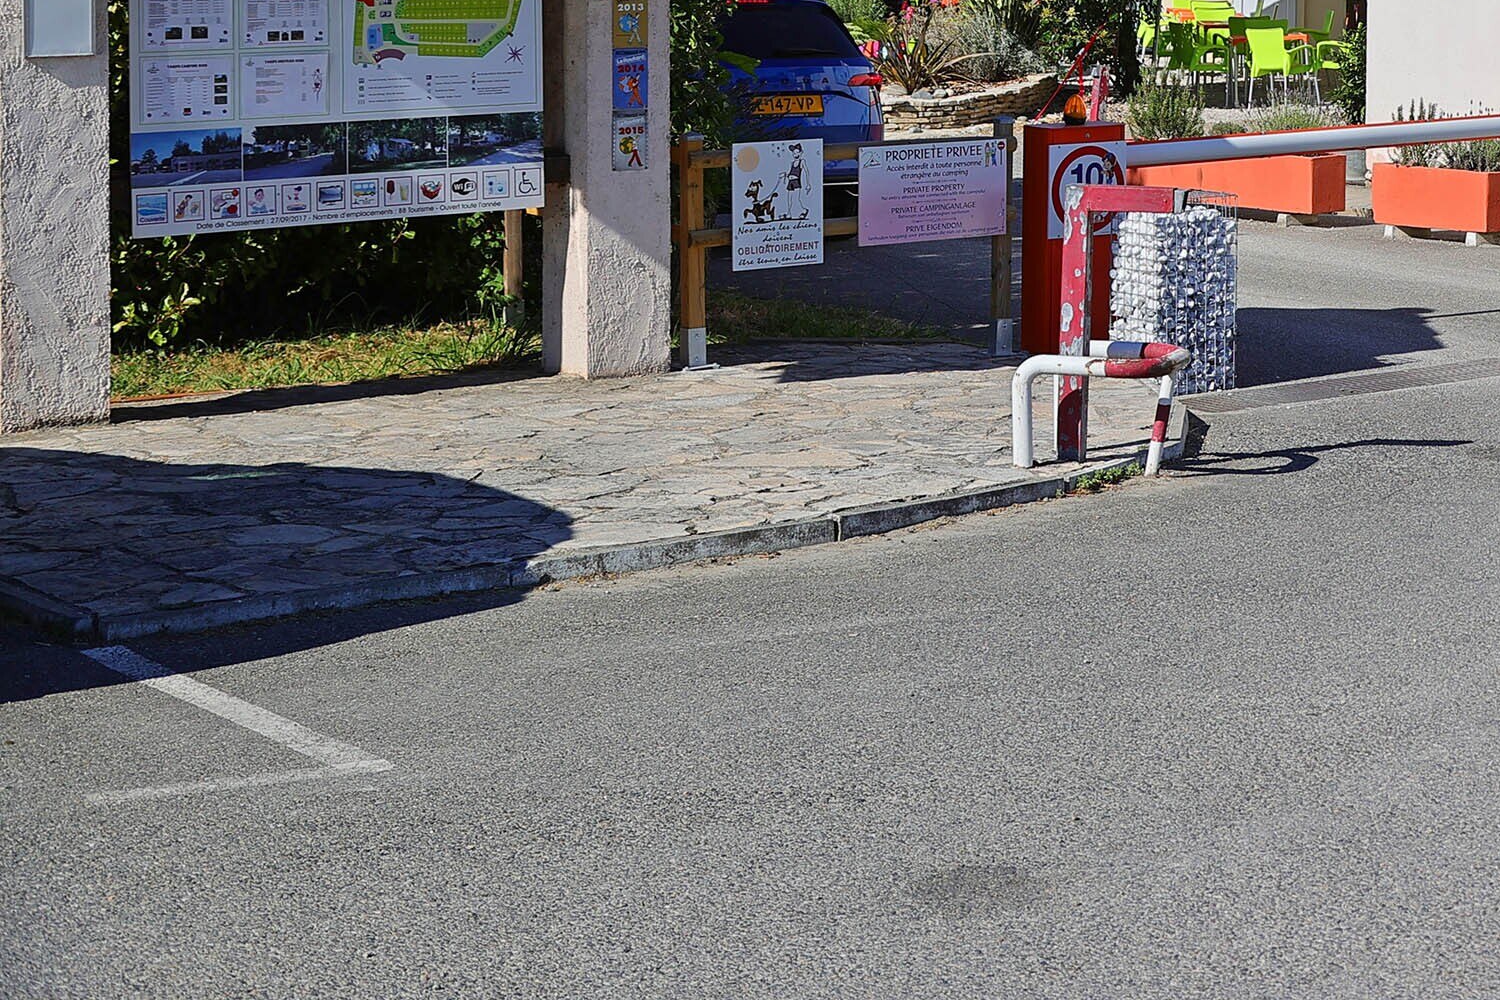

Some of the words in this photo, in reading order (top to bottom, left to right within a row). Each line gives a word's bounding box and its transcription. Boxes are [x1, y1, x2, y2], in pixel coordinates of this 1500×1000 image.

[617, 3, 645, 12] 2013
[617, 65, 645, 74] 2014
[618, 126, 644, 135] 2015
[906, 162, 929, 171] interdit
[936, 161, 953, 169] toute
[953, 160, 982, 169] personne
[942, 169, 969, 178] camping
[1071, 162, 1104, 185] 10
[903, 185, 930, 194] PRIVATE
[931, 183, 966, 193] PROPERTY
[891, 205, 918, 215] PRIVATE
[919, 201, 976, 213] CAMPINGANLAGE
[196, 222, 214, 230] Date
[216, 221, 225, 229] de
[226, 218, 265, 229] Classement
[312, 213, 339, 221] Nombre
[340, 207, 394, 219] d'emplacements
[408, 204, 435, 214] Tourisme
[439, 203, 461, 212] Ouvert
[462, 202, 478, 210] toute
[478, 200, 502, 208] l'année
[738, 226, 753, 236] Nos
[779, 222, 790, 230] les
[793, 221, 818, 230] chiens
[905, 224, 925, 233] PRIVE
[926, 221, 963, 232] EIGENDOM
[762, 234, 793, 243] doivent
[737, 241, 819, 256] OBLIGATOIREMENT
[757, 256, 779, 264] tenus
[794, 252, 817, 261] laisse
